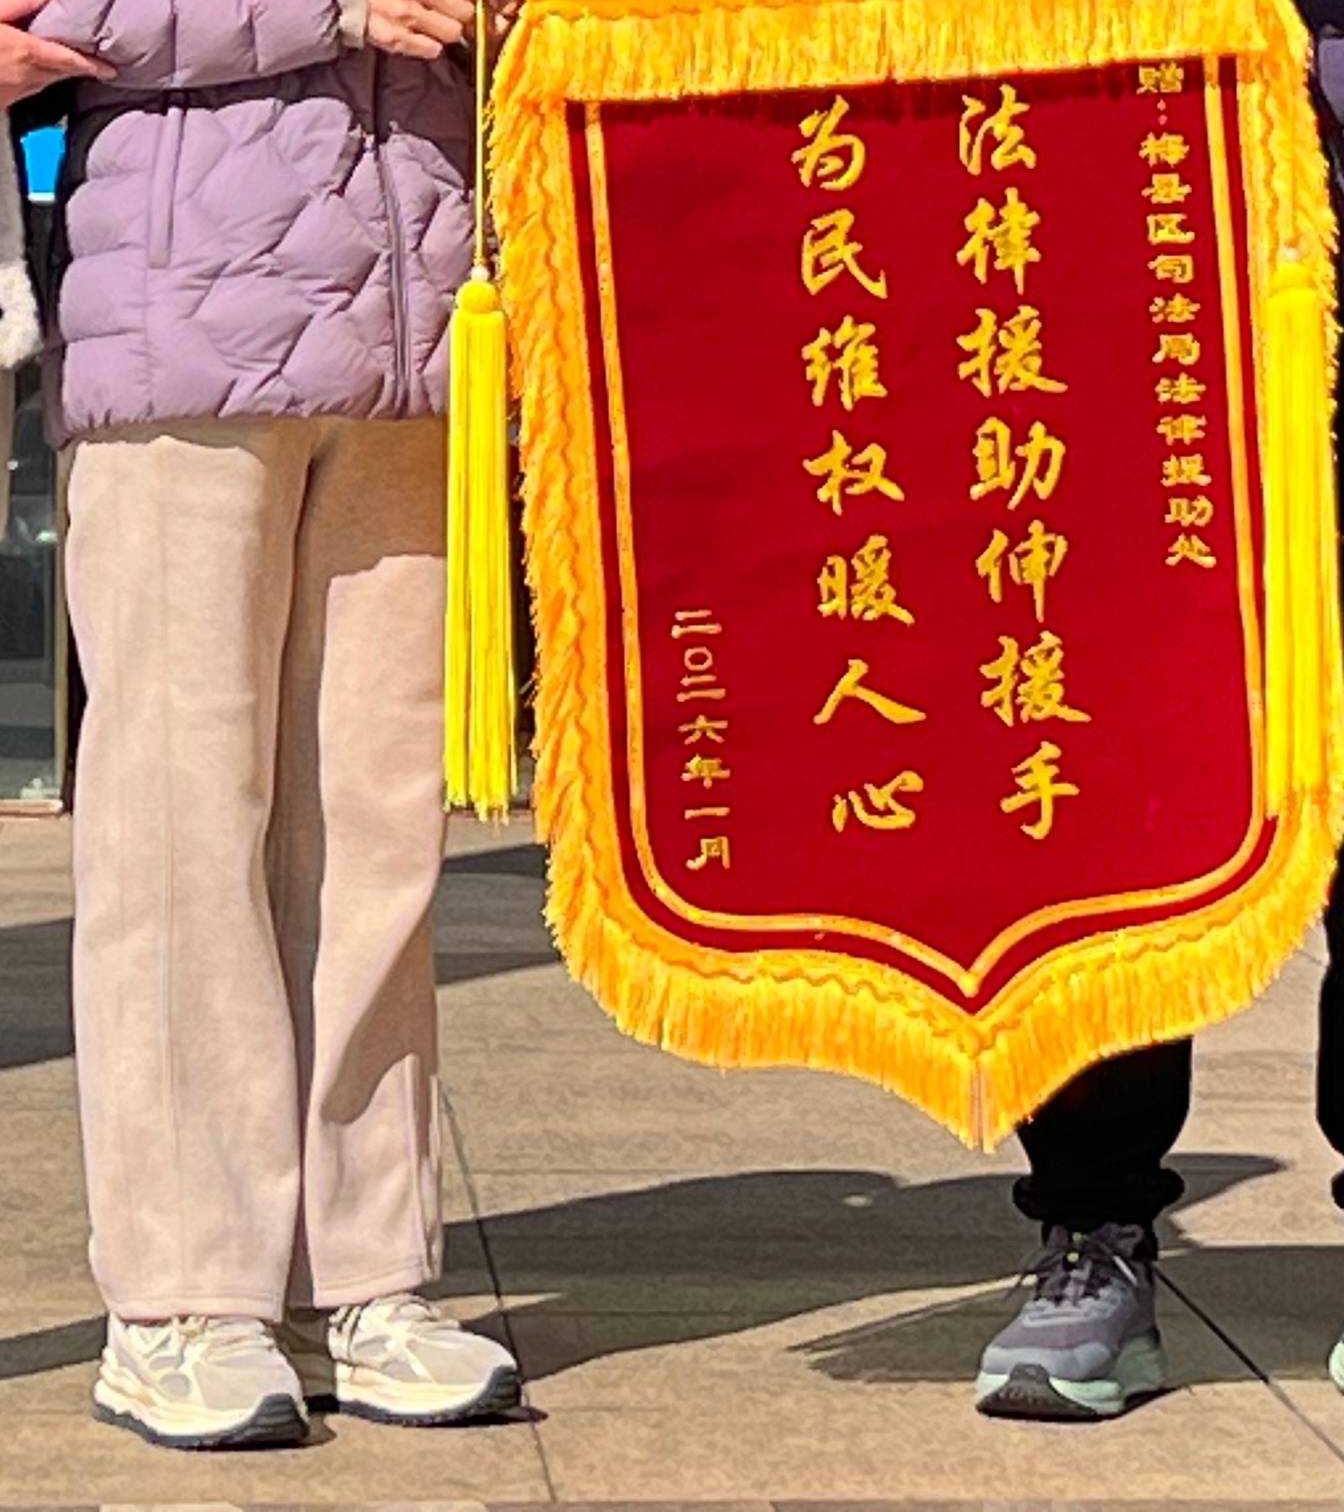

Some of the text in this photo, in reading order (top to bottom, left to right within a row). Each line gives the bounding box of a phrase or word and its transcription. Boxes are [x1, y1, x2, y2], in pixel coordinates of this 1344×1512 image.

[791, 97, 927, 835] 为民维权暖人心
[954, 82, 1093, 841] 法律援助伸援手
